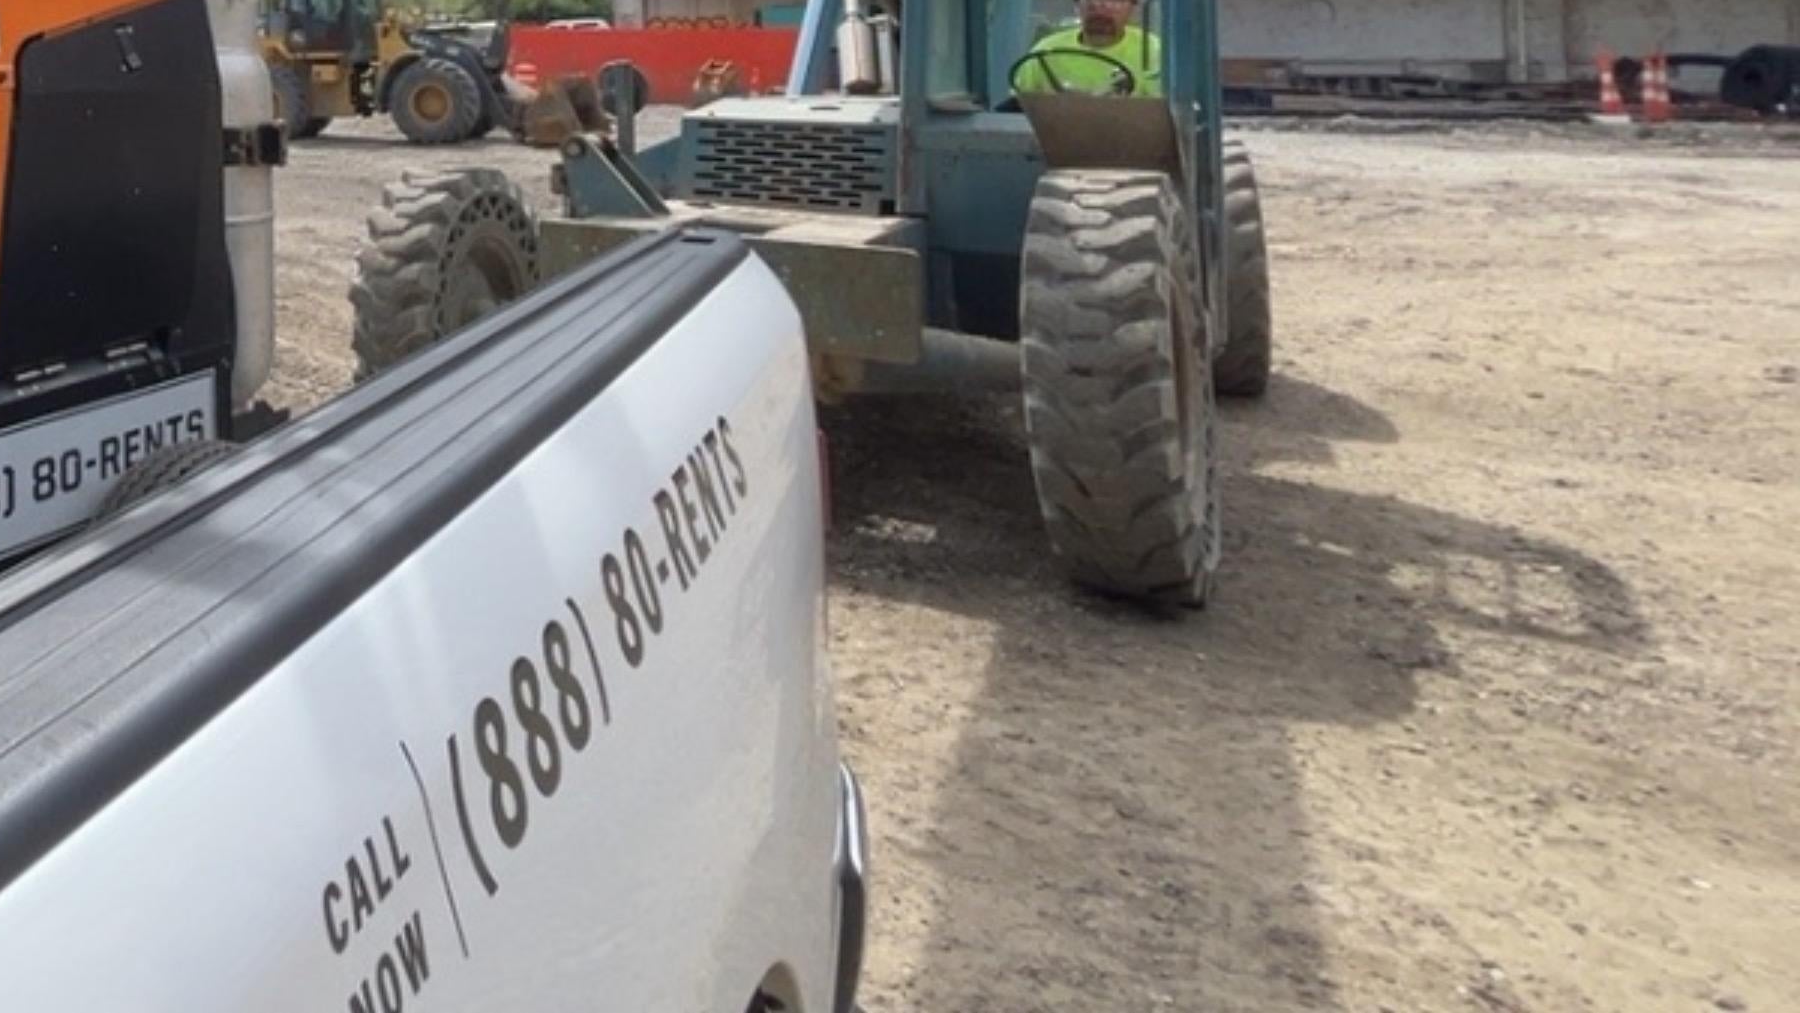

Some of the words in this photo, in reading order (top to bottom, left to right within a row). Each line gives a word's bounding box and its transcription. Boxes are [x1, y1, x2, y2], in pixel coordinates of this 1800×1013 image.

[446, 598, 611, 897] (888)
[601, 415, 750, 669] 80-RENTS
[322, 815, 412, 954] CALL
